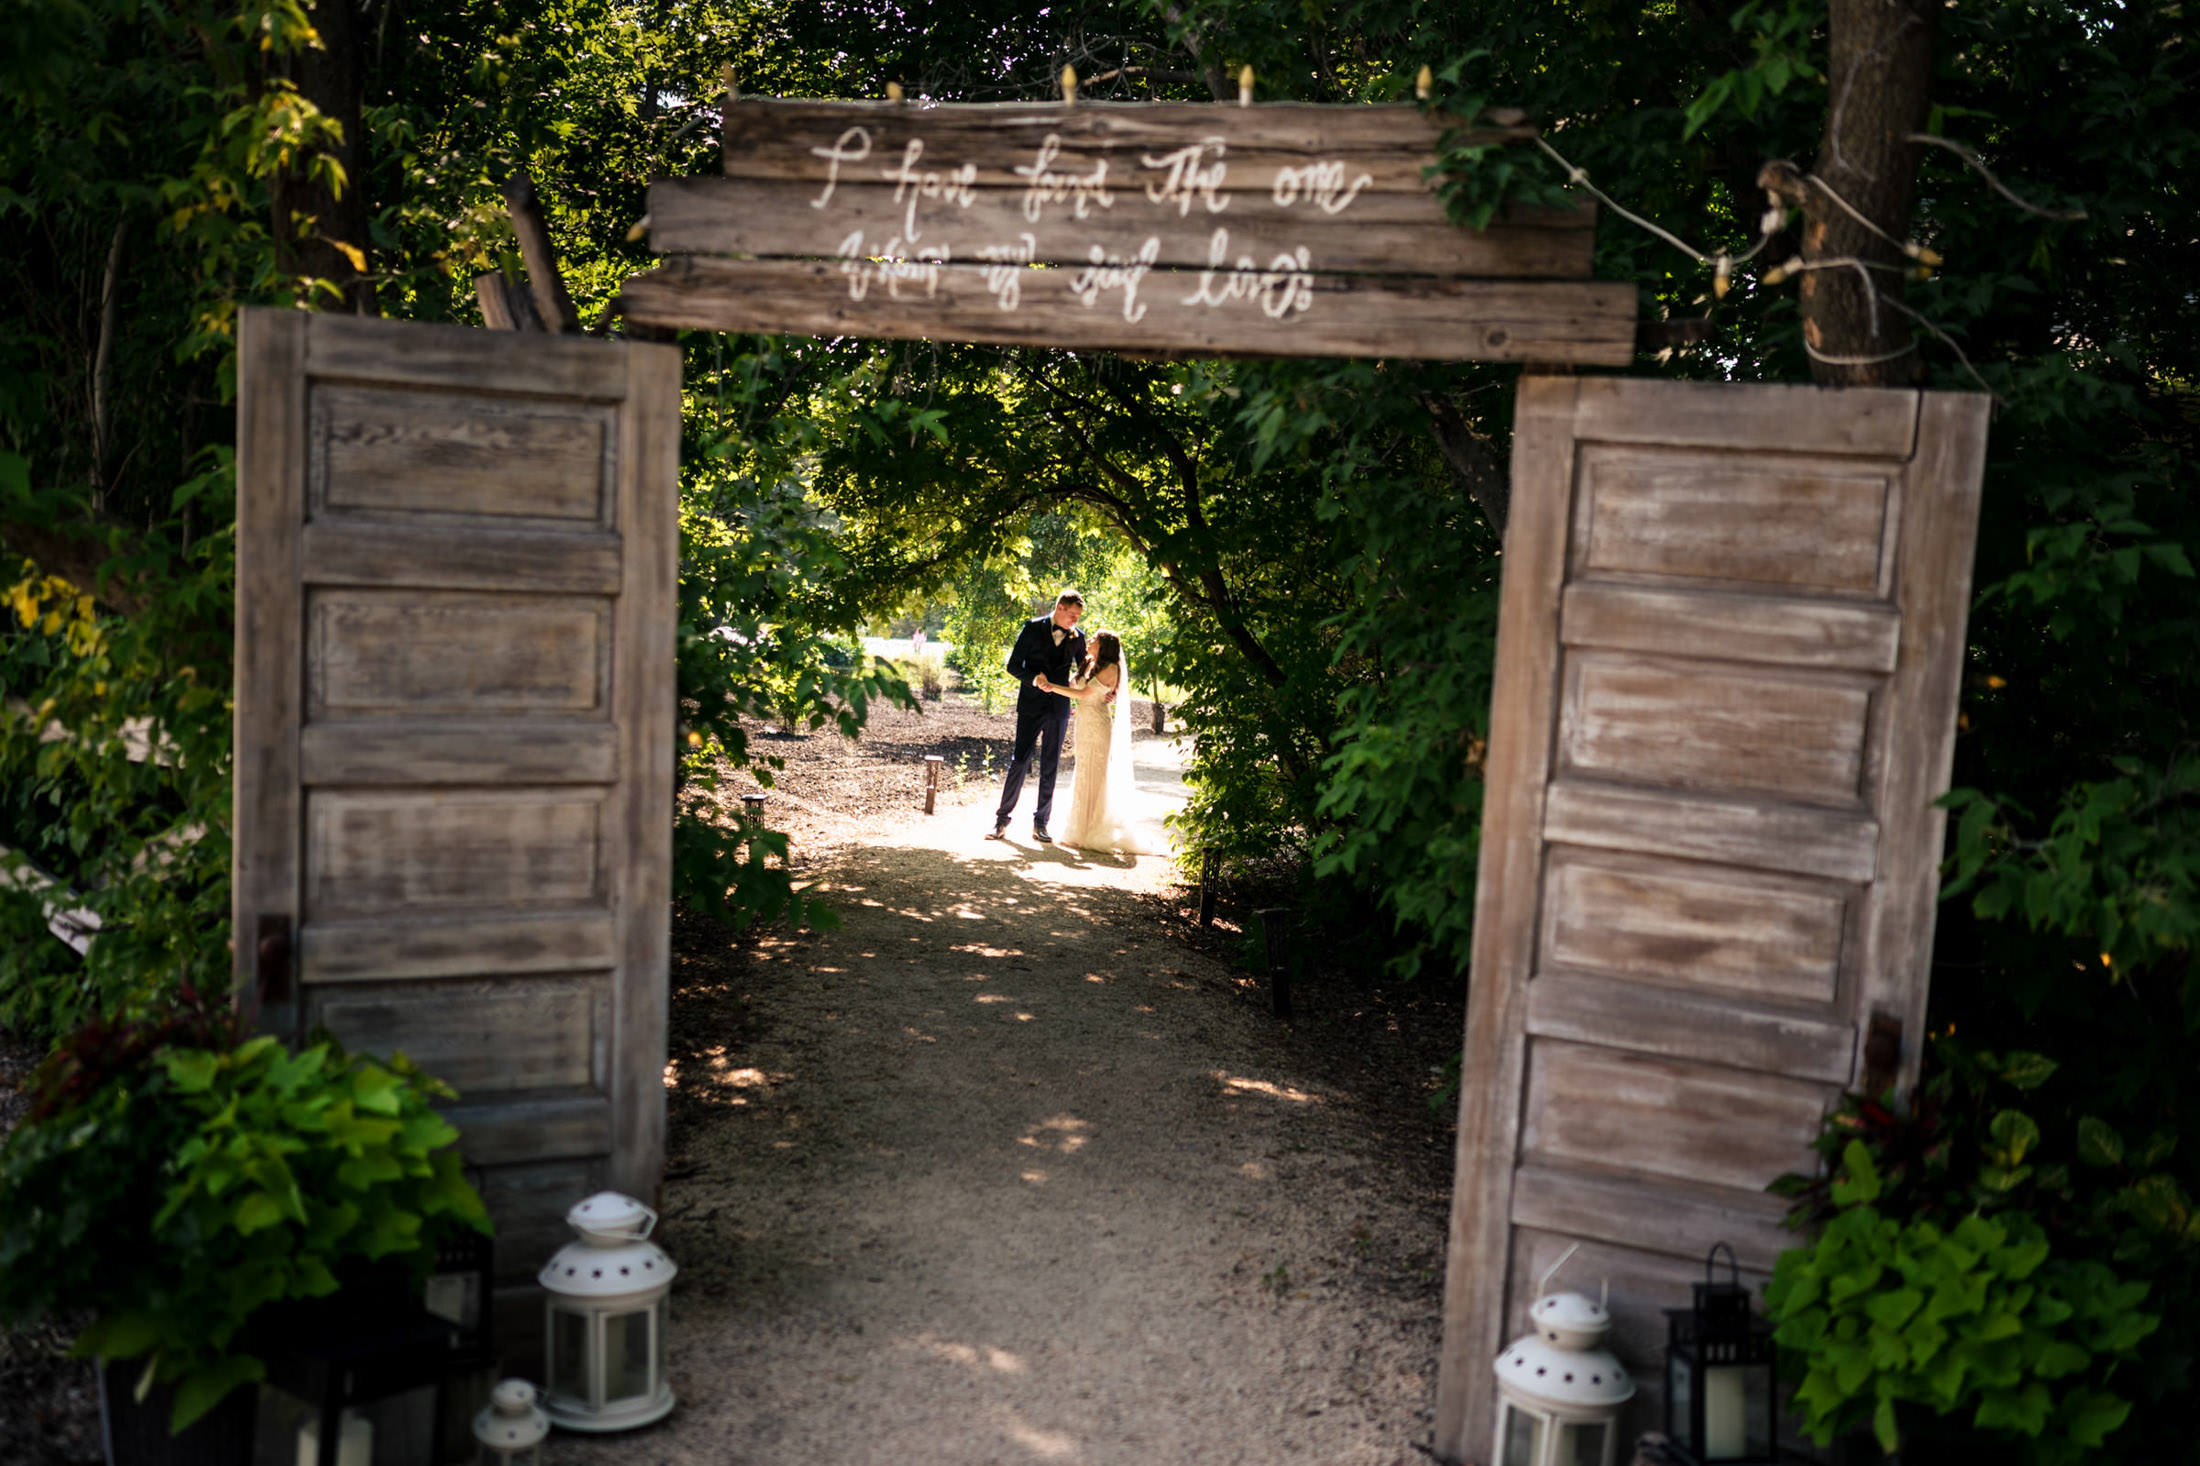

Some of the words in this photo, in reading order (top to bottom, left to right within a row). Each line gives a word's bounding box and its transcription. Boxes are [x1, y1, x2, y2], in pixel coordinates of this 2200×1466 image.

[810, 126, 872, 209] I
[881, 138, 979, 243] have
[1014, 133, 1115, 223] found
[1272, 160, 1374, 214] one
[976, 232, 1037, 312] my
[1070, 235, 1162, 324] soul
